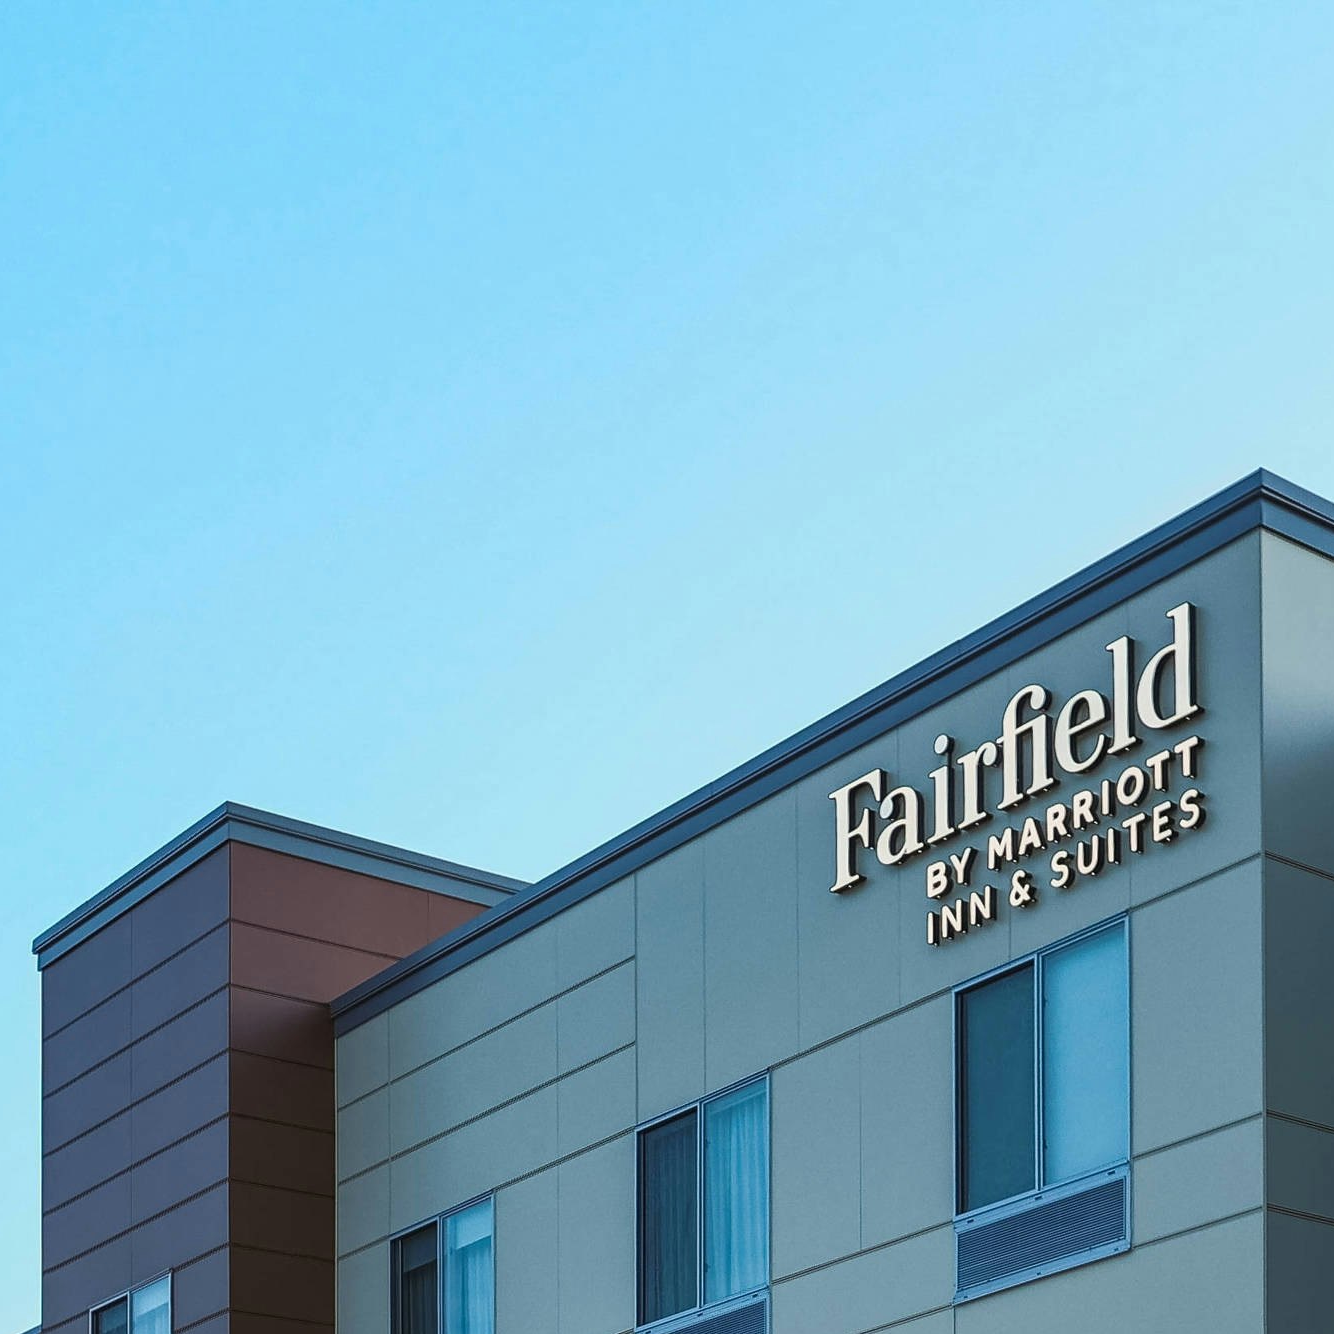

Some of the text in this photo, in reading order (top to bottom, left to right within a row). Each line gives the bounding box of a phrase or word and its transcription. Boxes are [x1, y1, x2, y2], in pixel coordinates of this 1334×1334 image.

[828, 601, 1201, 893] Fairfield
[926, 735, 1202, 899] BY MARRIOTT
[927, 789, 1204, 945] INN & SUITES
